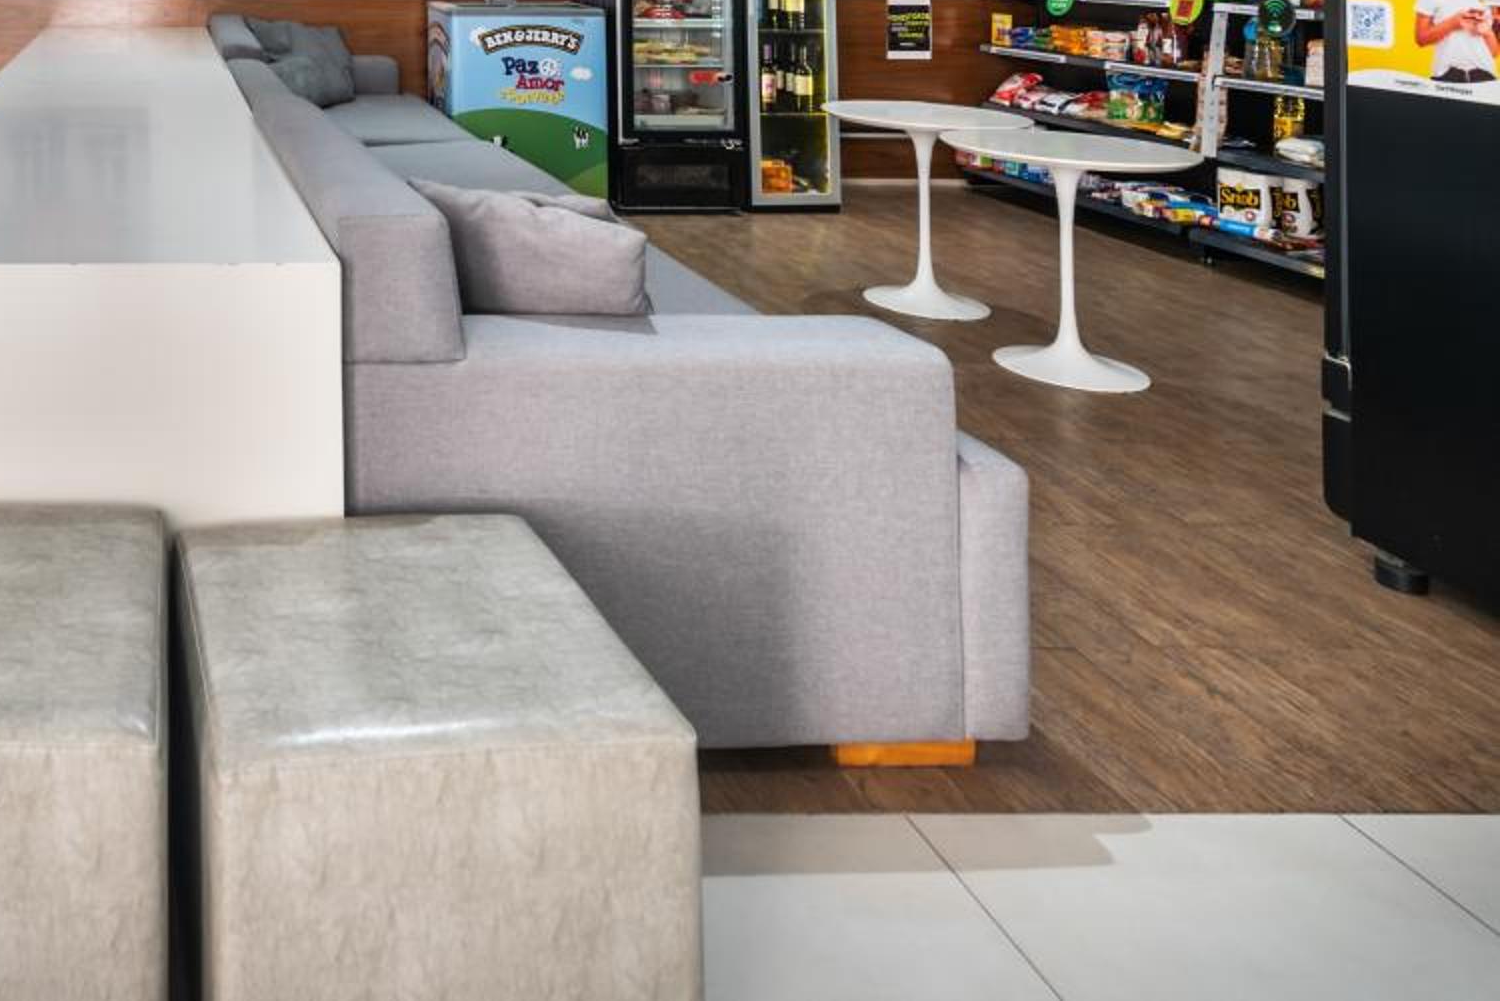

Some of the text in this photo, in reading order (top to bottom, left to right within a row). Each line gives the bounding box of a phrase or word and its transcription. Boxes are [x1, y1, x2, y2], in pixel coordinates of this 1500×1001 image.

[502, 56, 539, 75] Paz
[516, 75, 565, 91] Amor
[1221, 187, 1260, 206] Snob
